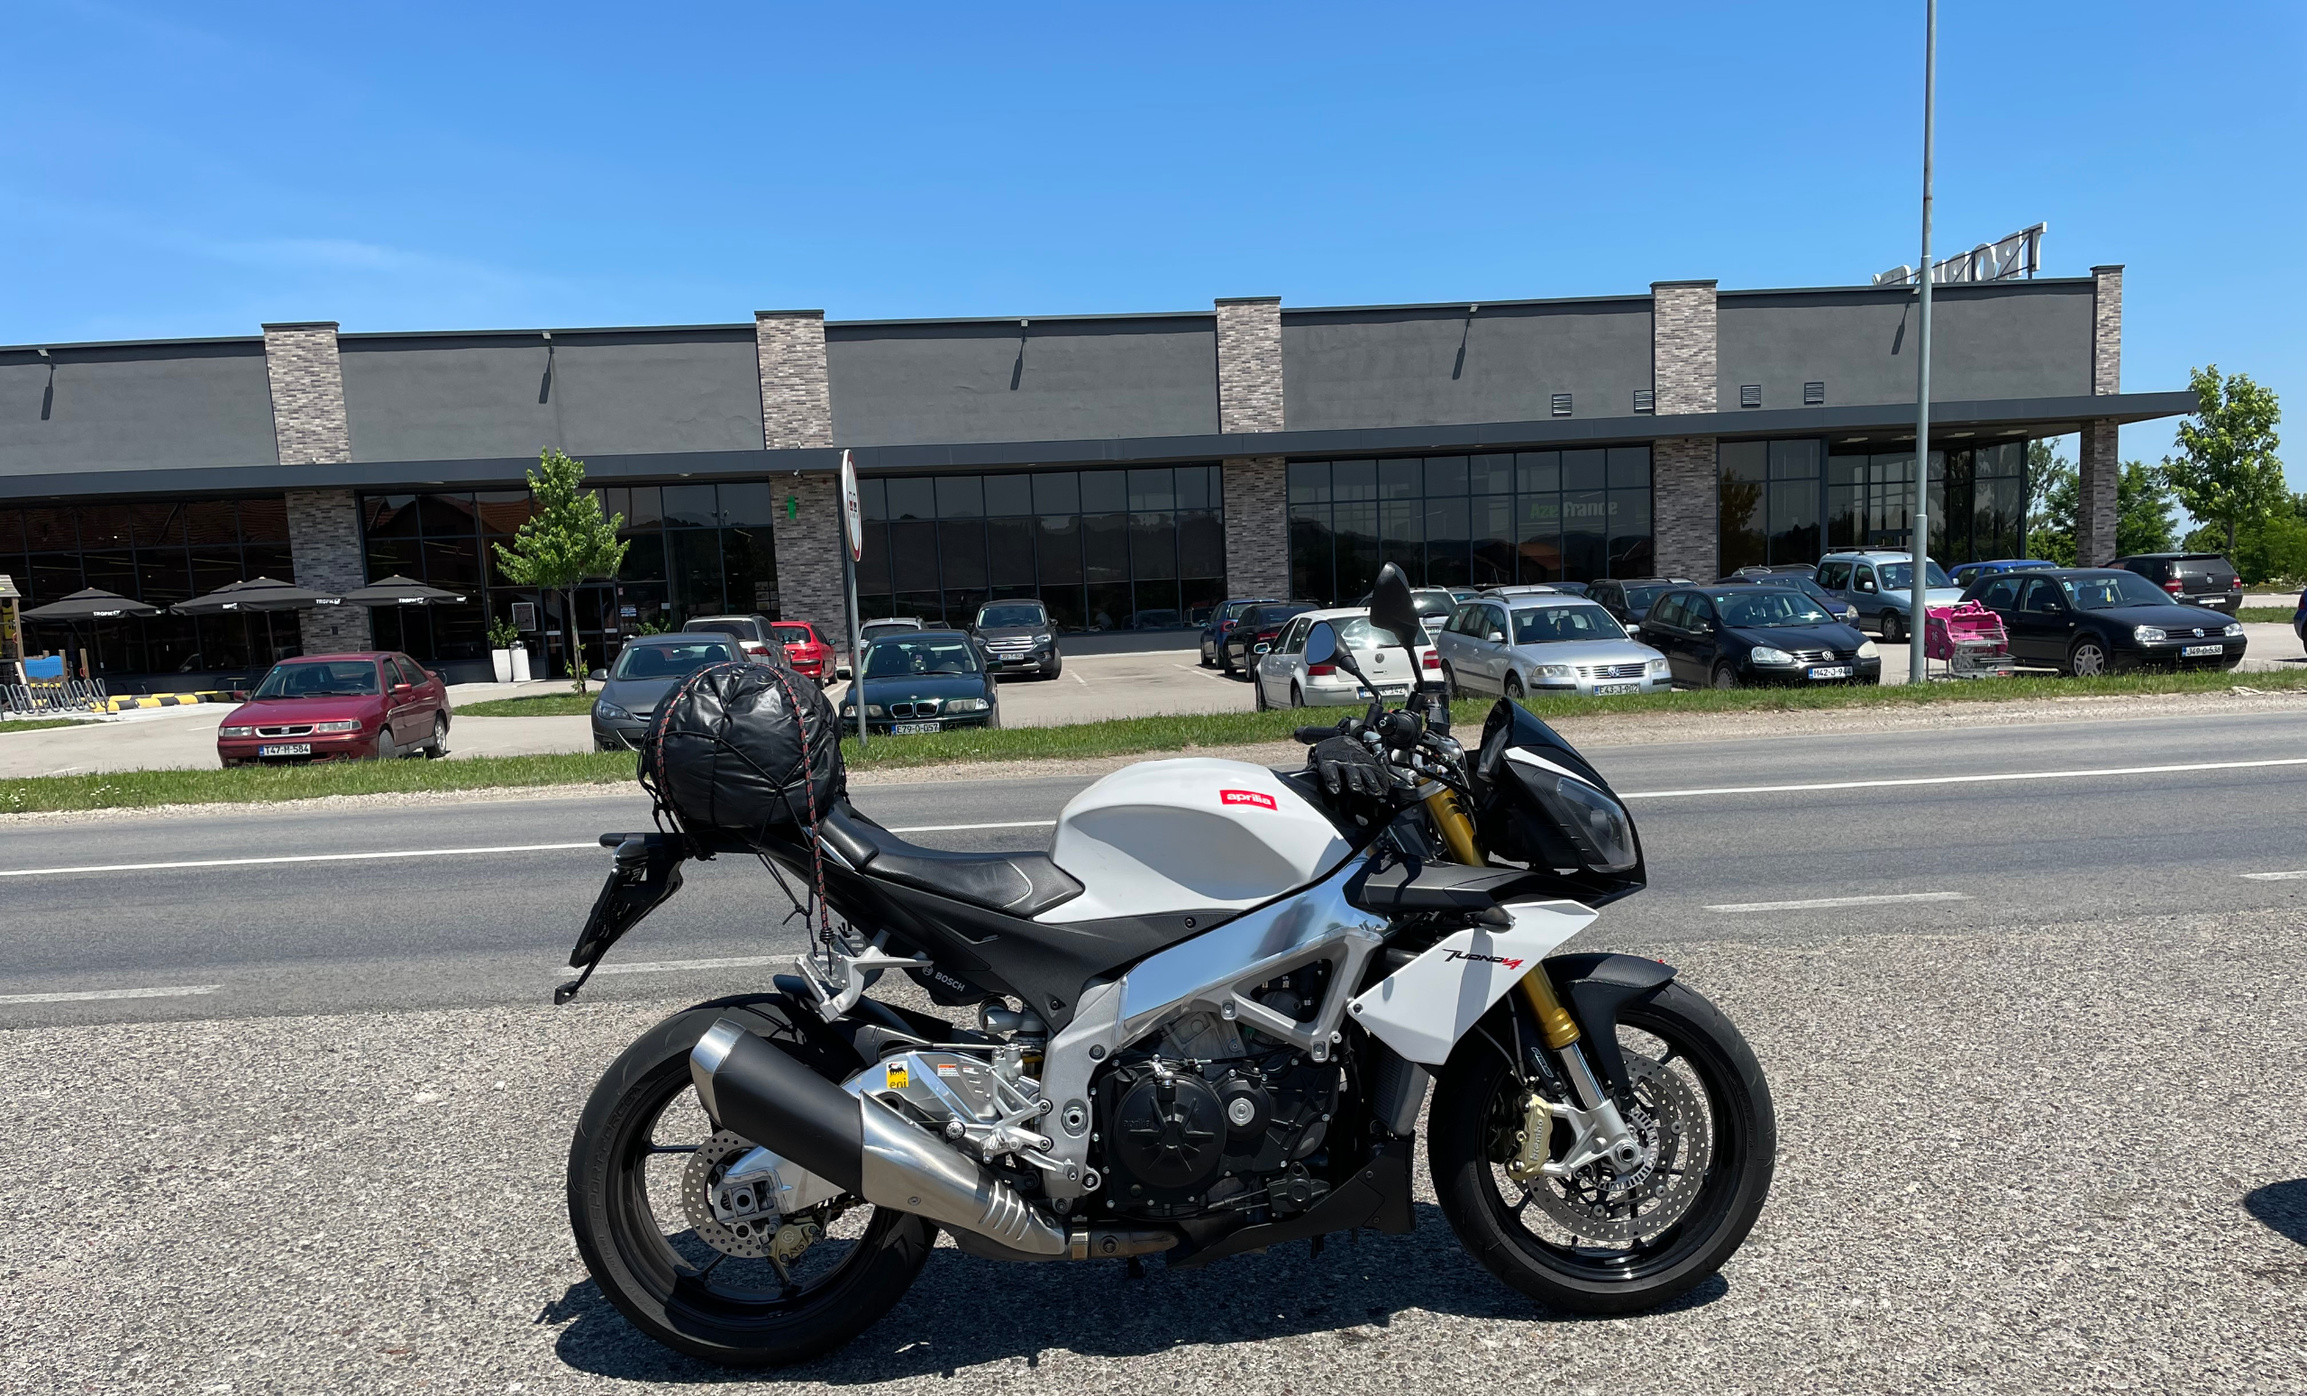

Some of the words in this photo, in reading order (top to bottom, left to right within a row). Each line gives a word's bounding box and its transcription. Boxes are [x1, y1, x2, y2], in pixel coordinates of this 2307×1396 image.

[1227, 793, 1272, 805] aprilia
[935, 972, 966, 992] BOSCH
[889, 1078, 907, 1089] eni
[1530, 1119, 1543, 1161] brembo
